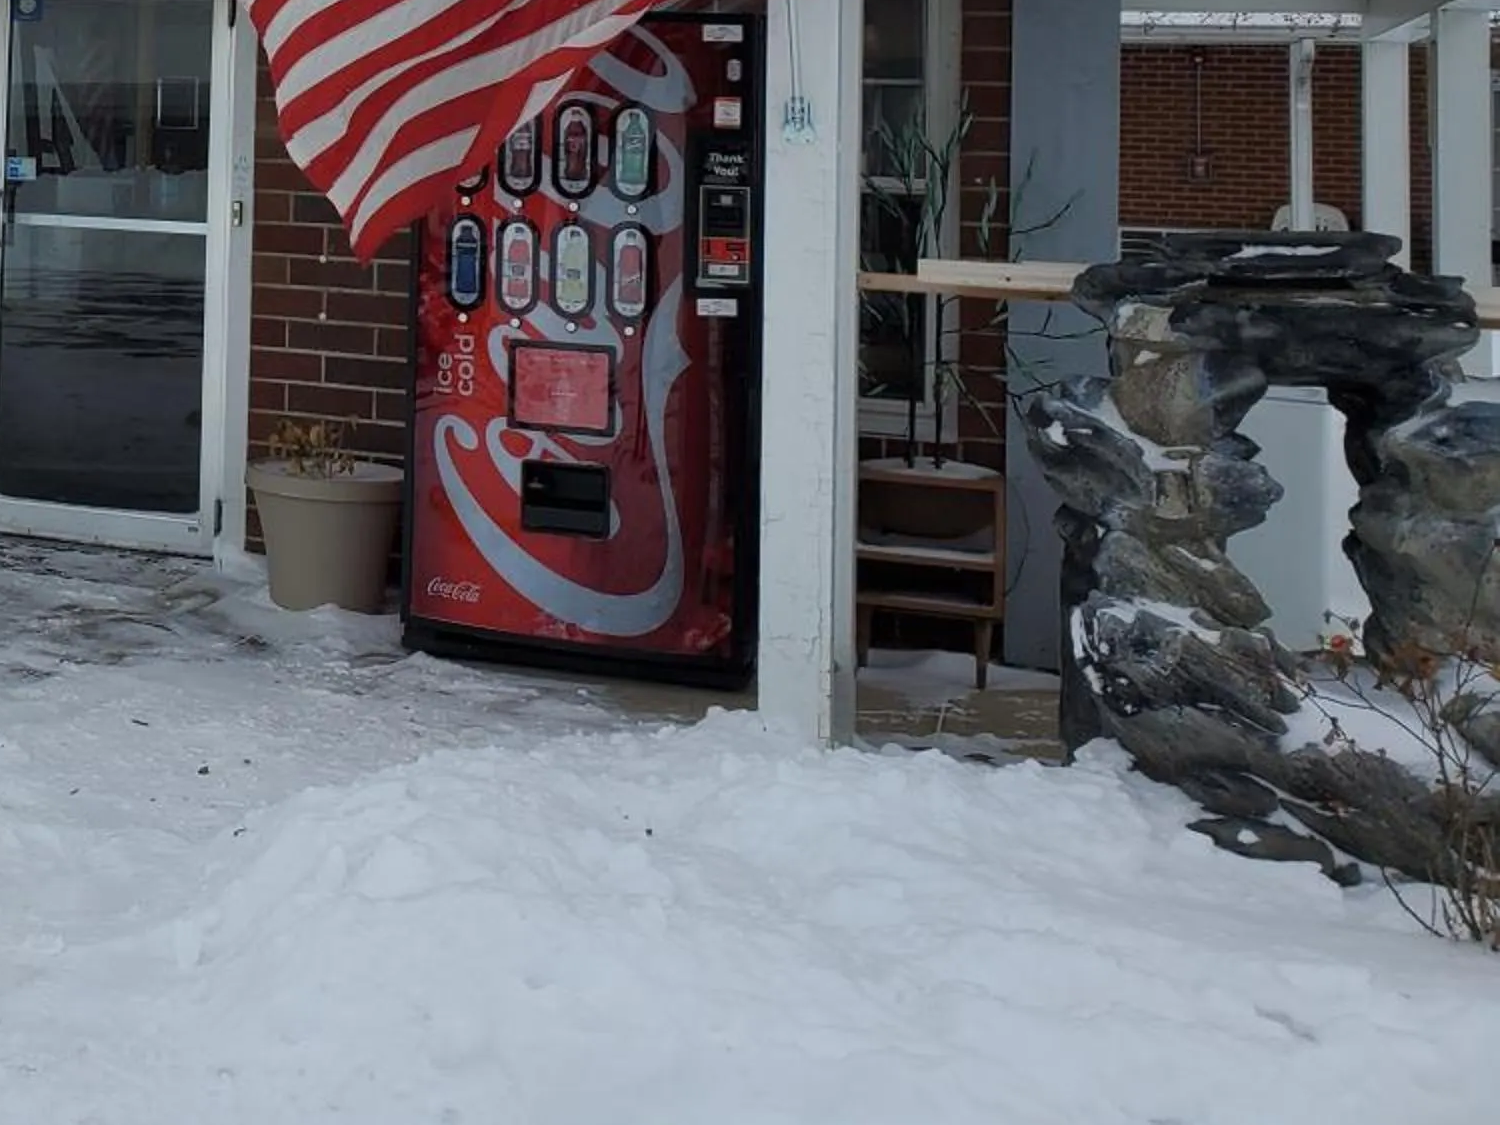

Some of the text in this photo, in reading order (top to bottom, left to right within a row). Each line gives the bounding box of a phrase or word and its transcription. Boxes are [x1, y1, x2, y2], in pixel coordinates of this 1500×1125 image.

[708, 152, 745, 164] Thank
[433, 352, 453, 393] ice
[453, 334, 475, 396] cold
